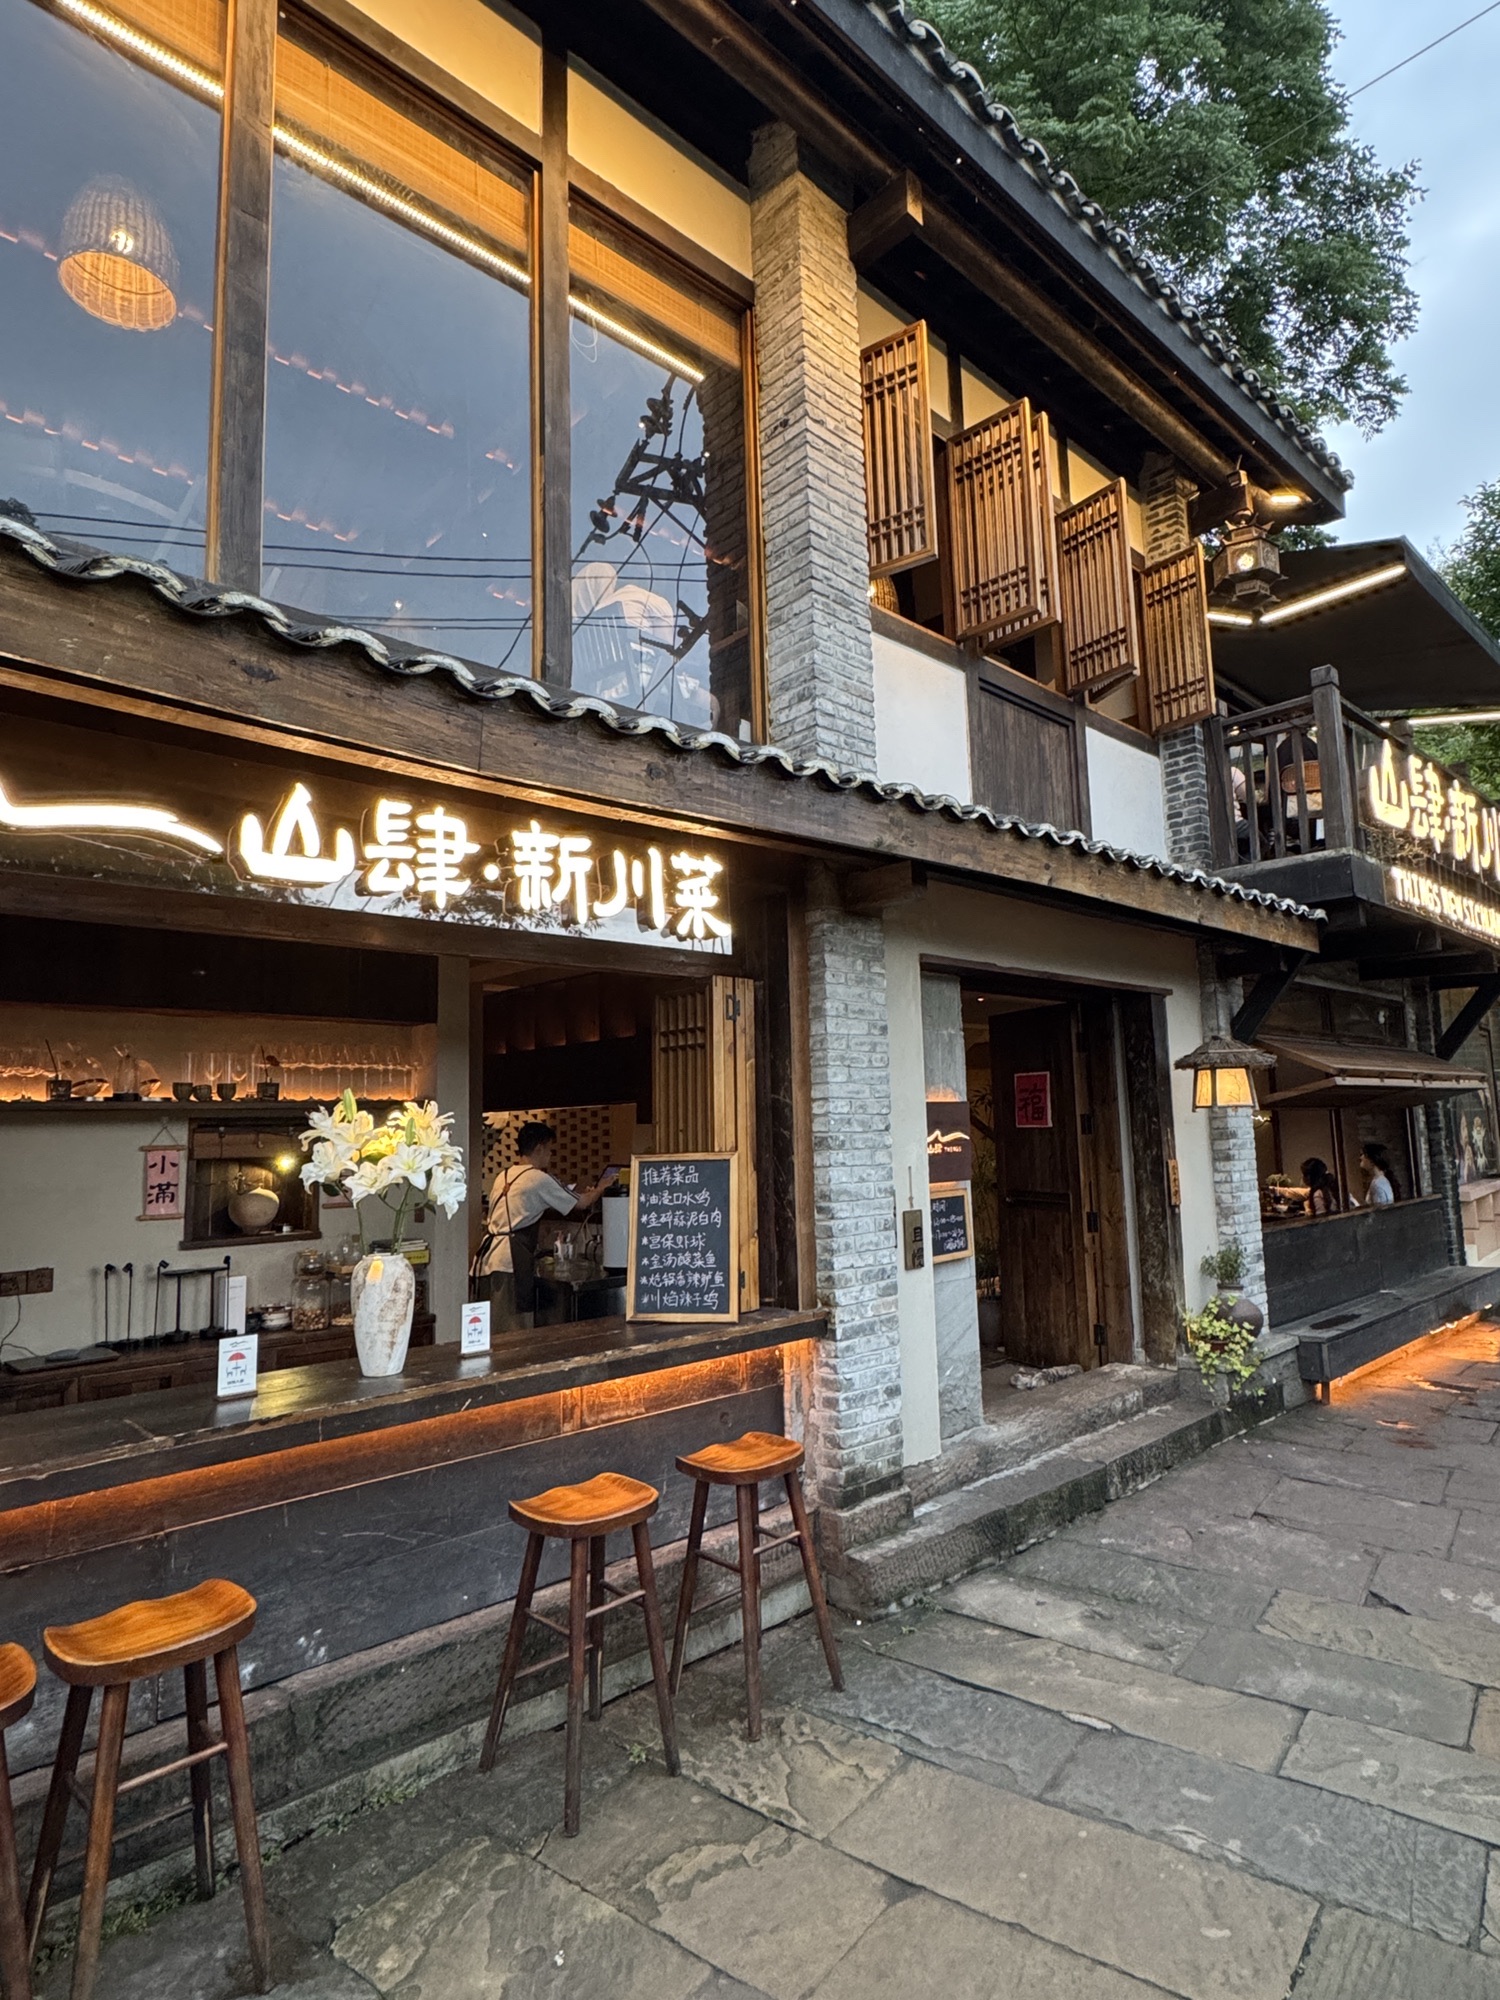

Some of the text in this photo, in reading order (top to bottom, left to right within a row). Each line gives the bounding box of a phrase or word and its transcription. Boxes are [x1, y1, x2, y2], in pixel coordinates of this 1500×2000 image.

[1391, 866, 1441, 915] THINGS
[641, 1164, 699, 1187] 推荐菜品
[649, 1232, 706, 1251] 宫保虾球
[649, 1250, 717, 1270] 金汤酸菜鱼
